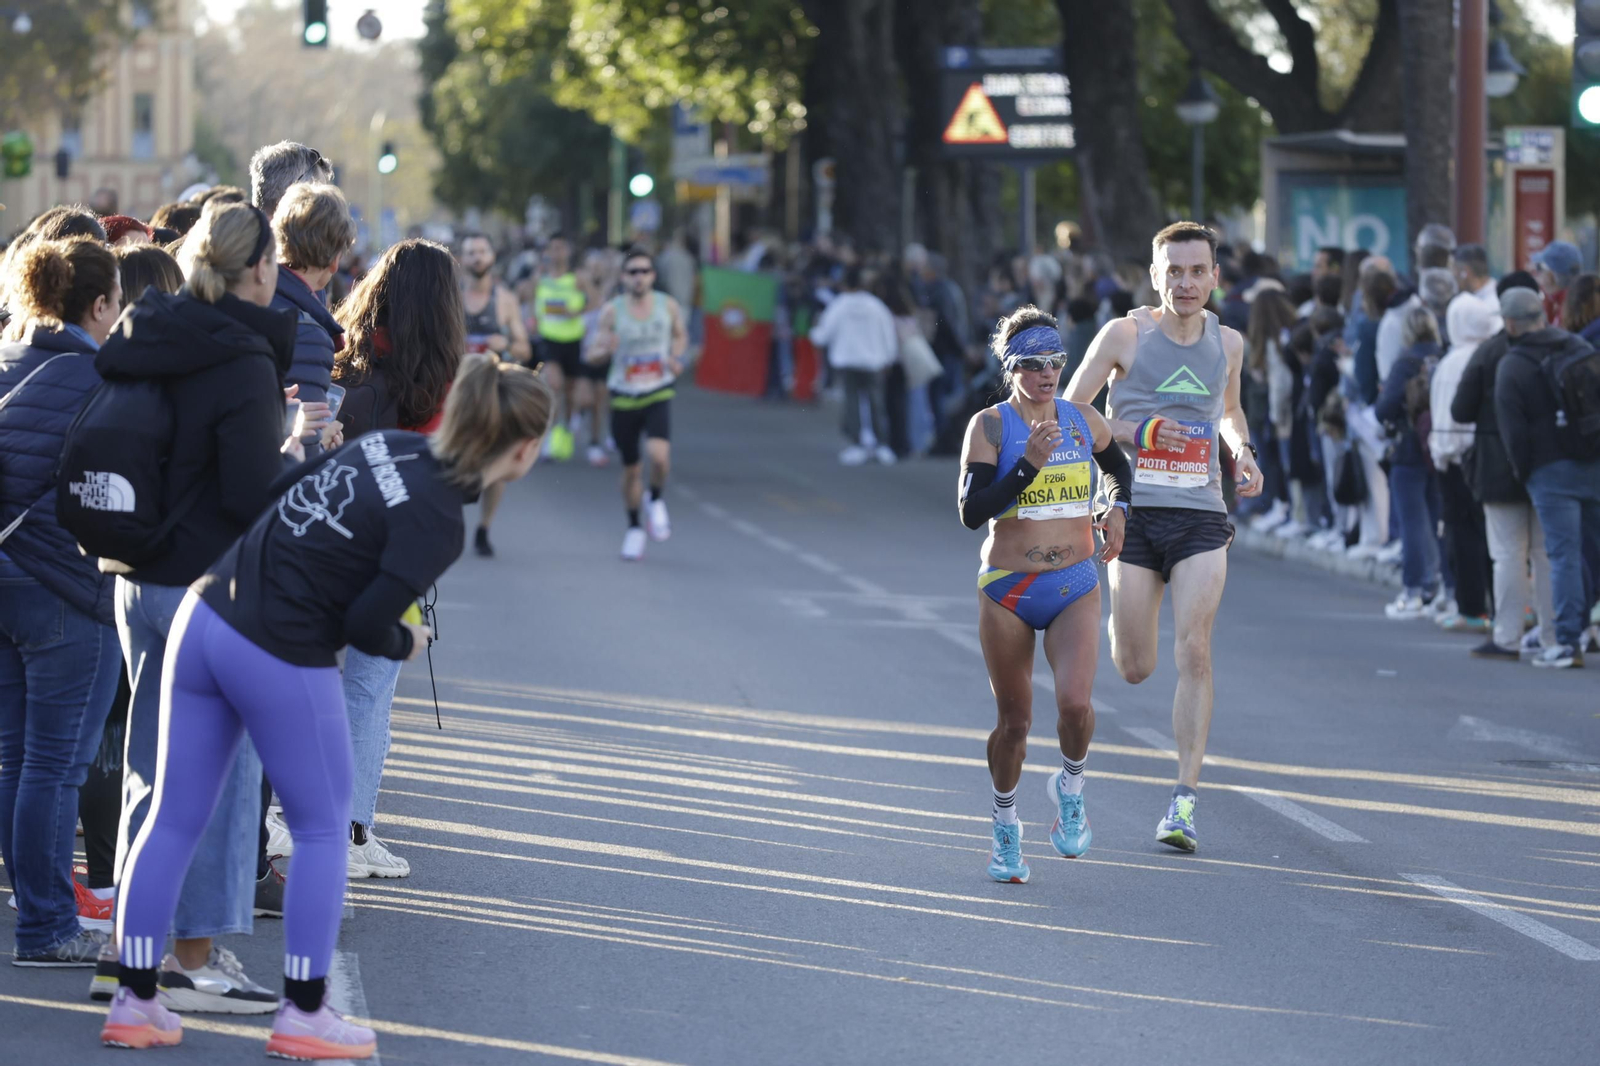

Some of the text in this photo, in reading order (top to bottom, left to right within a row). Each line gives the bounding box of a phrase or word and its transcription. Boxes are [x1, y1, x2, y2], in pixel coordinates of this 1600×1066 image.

[1298, 213, 1390, 260] NO
[1047, 450, 1081, 463] URICH
[1137, 457, 1208, 473] PIOTR CHOROS
[83, 470, 109, 484] THE
[370, 462, 411, 508] ROBIN
[1044, 472, 1067, 484] F266
[69, 481, 108, 497] NORTH
[1018, 484, 1089, 505] ROSA ALVA
[80, 494, 108, 510] FACE
